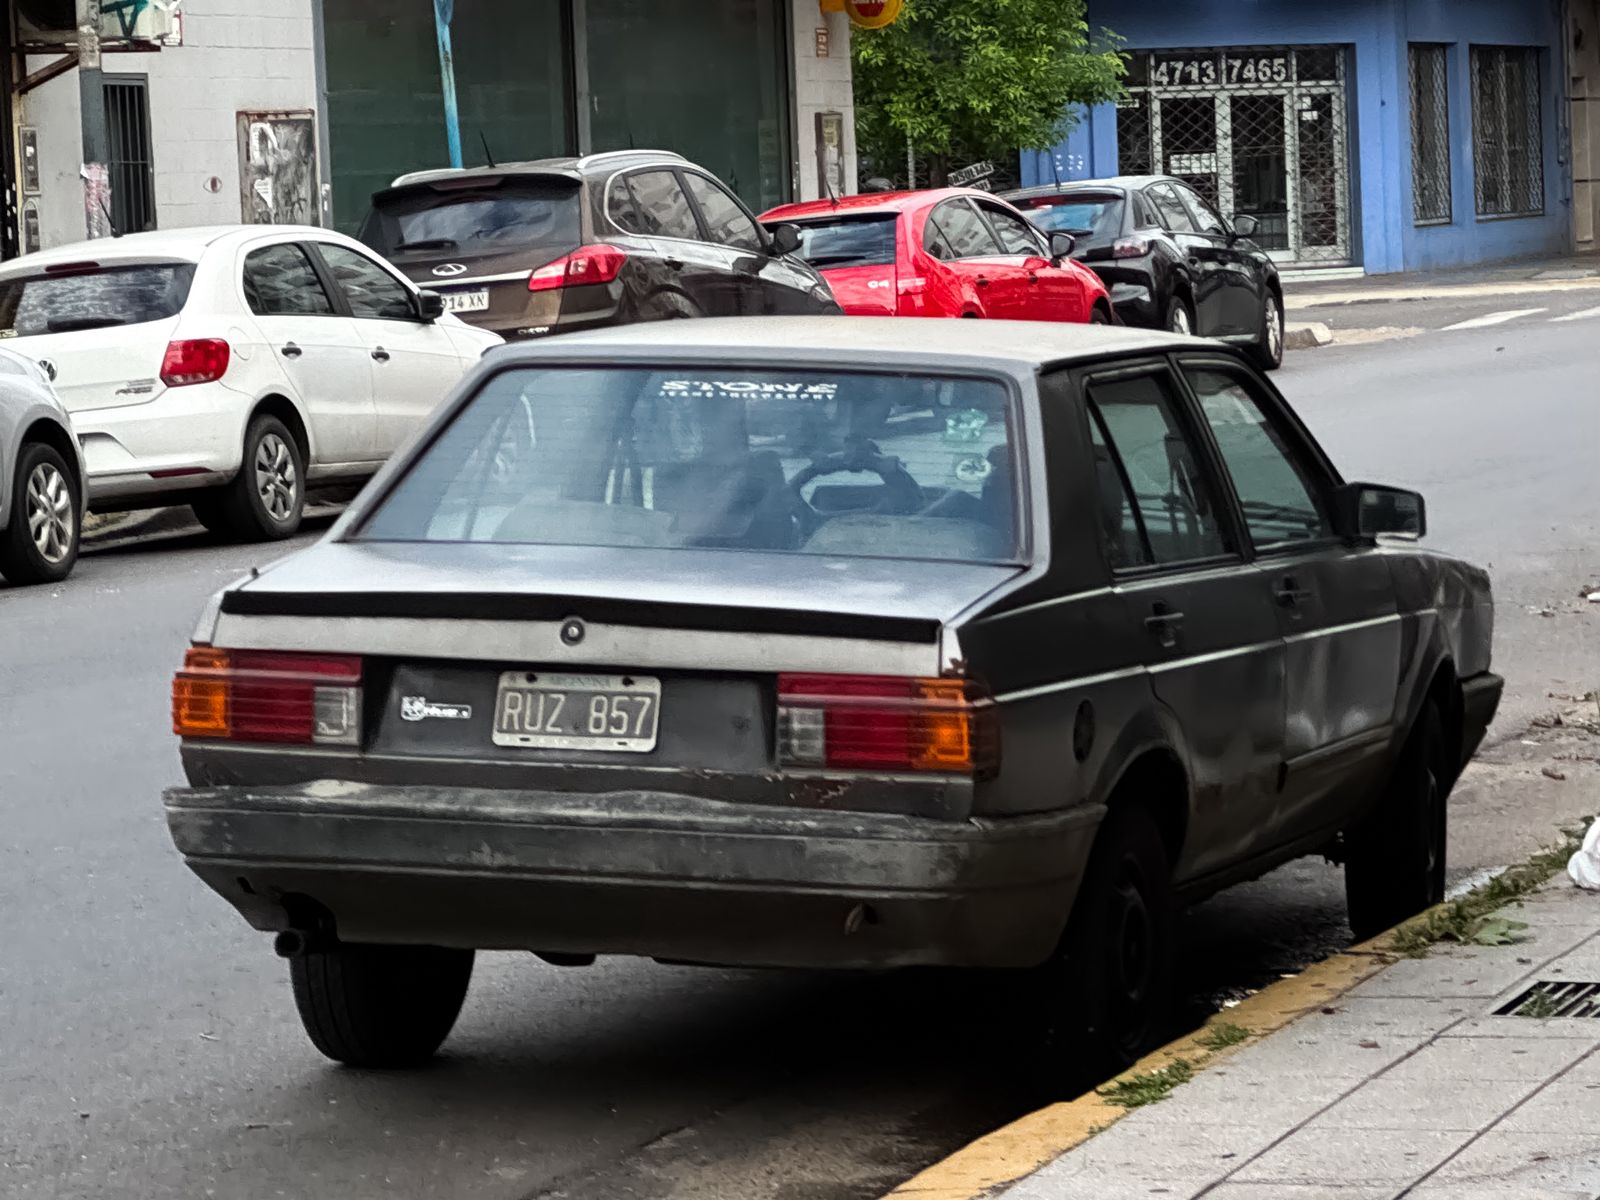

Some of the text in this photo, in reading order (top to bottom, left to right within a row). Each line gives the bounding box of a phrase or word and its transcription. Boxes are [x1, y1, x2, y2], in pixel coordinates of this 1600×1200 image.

[1155, 58, 1287, 86] 4713 7465
[502, 691, 566, 733] RUZ
[588, 694, 652, 736] 857
